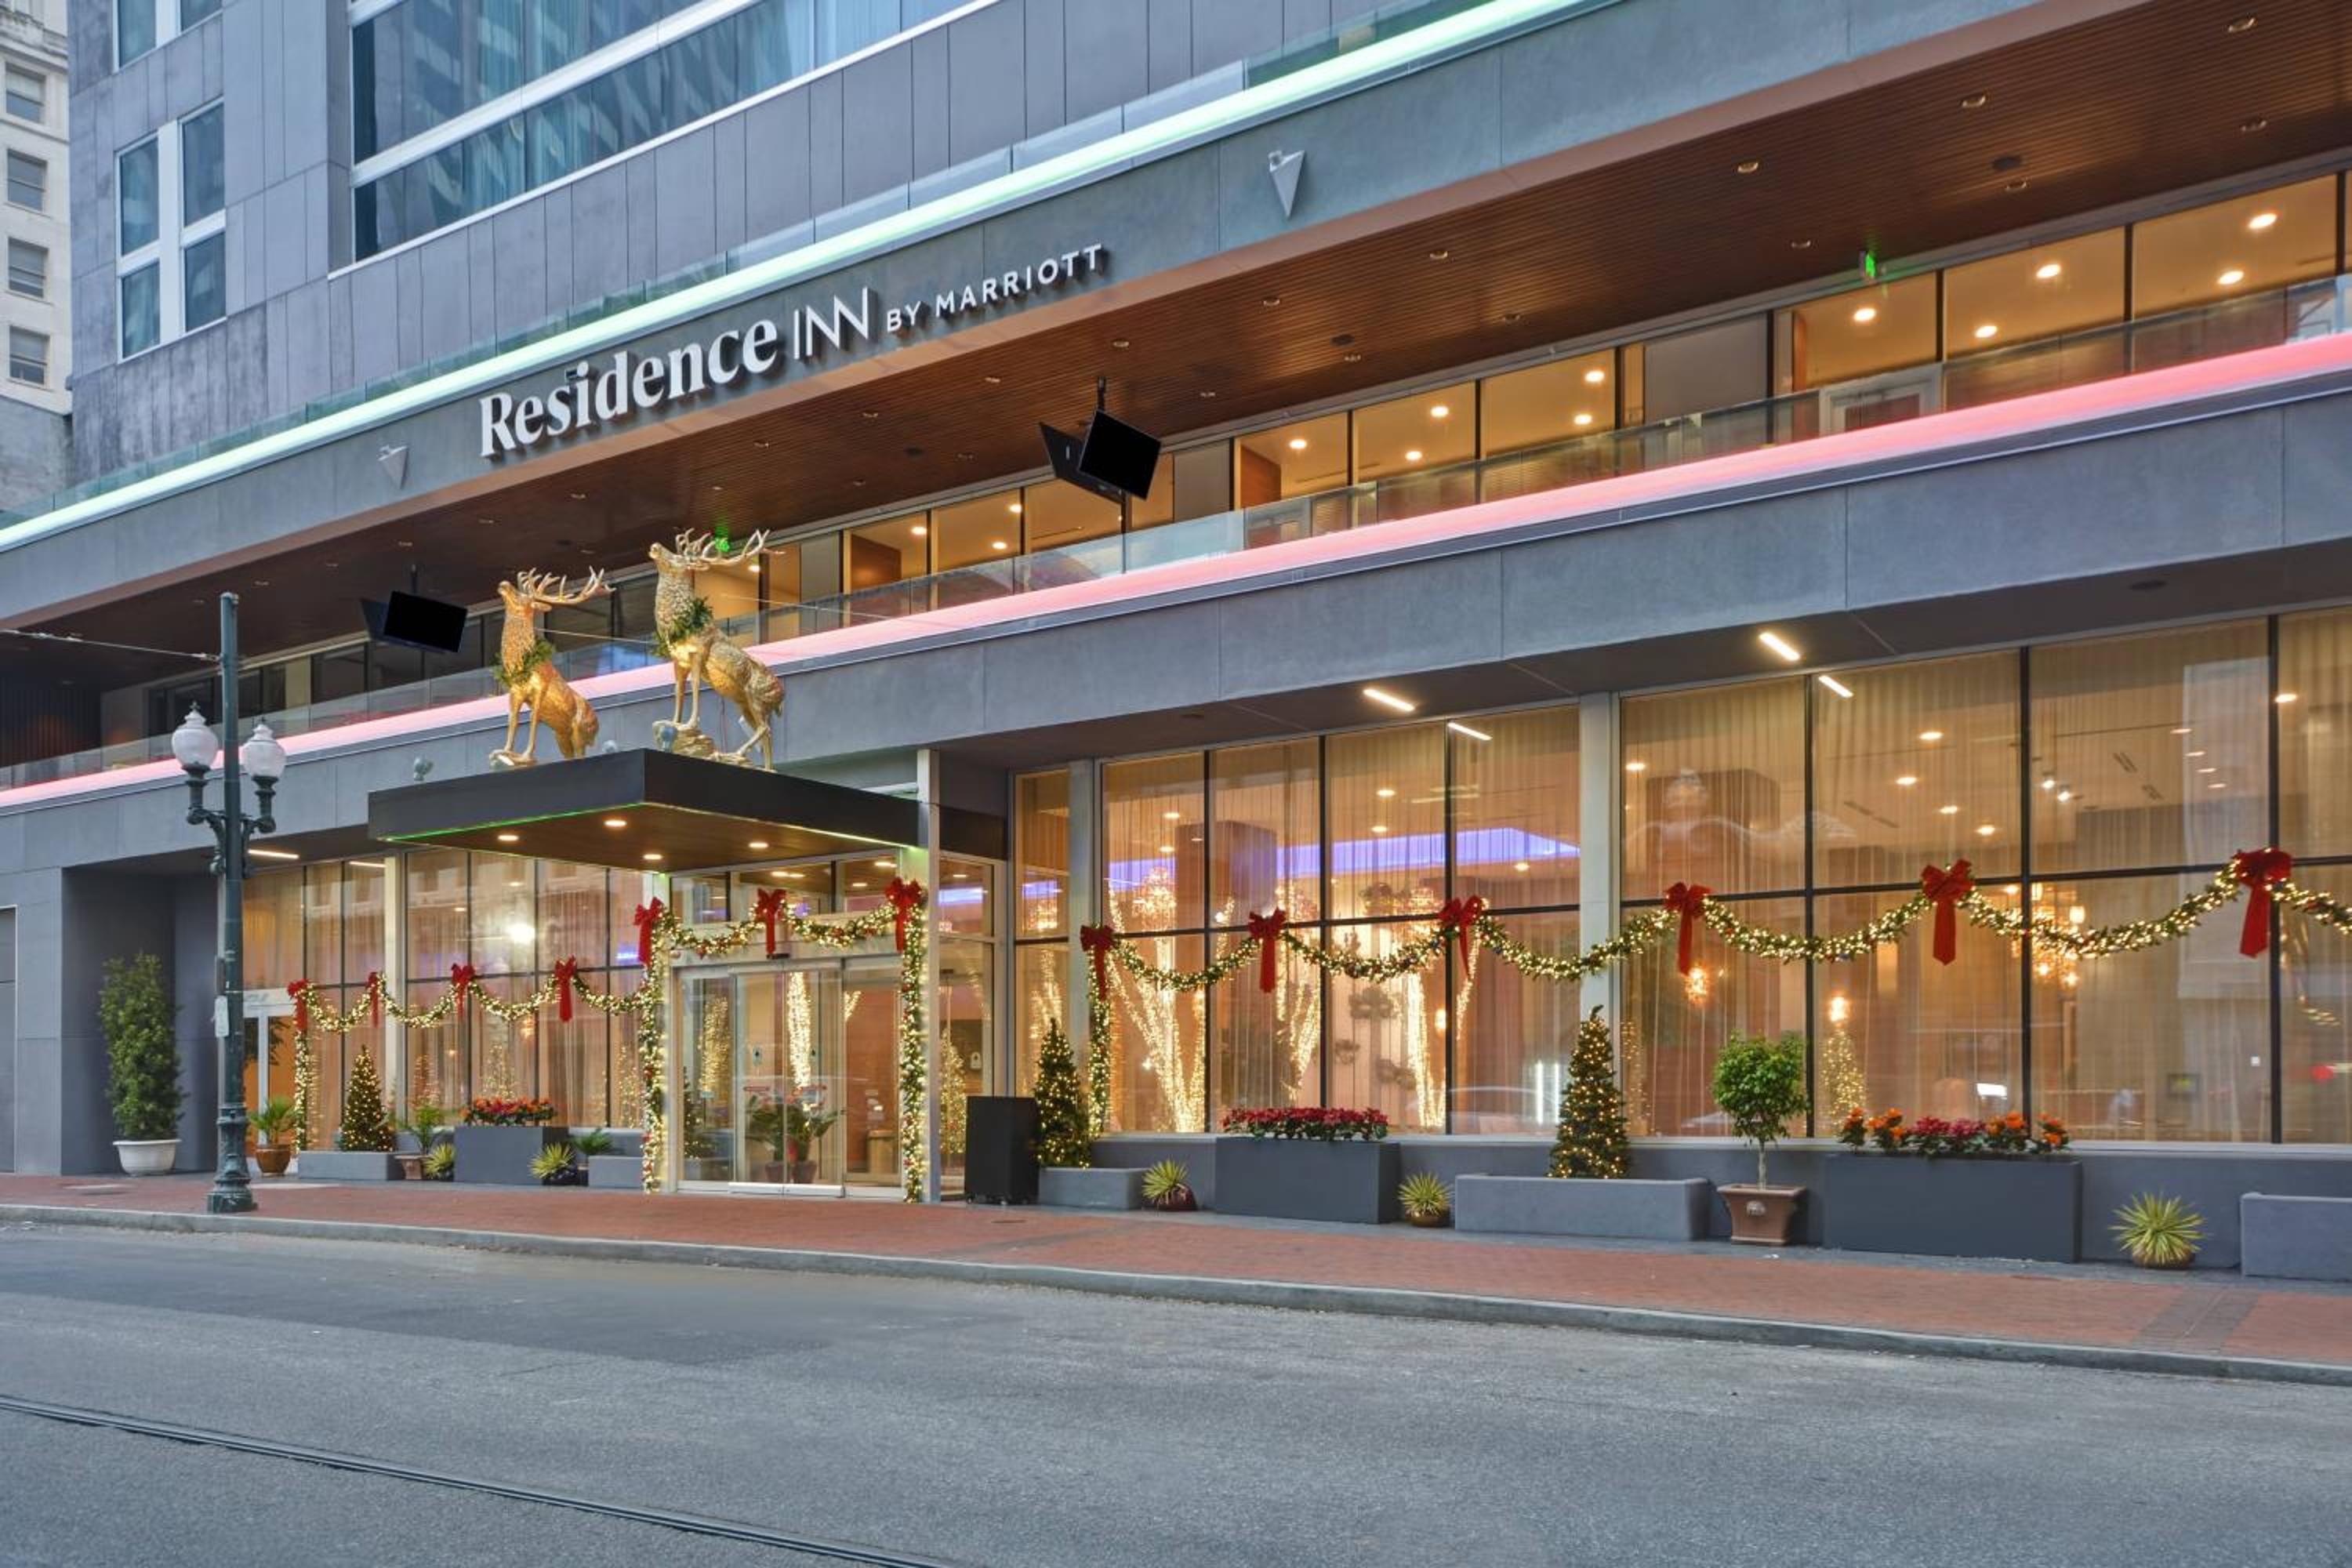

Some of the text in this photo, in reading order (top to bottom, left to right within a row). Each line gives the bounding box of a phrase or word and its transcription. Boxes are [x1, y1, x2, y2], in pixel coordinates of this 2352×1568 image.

[479, 244, 1102, 457] Residence INN BY MARRIOTT
